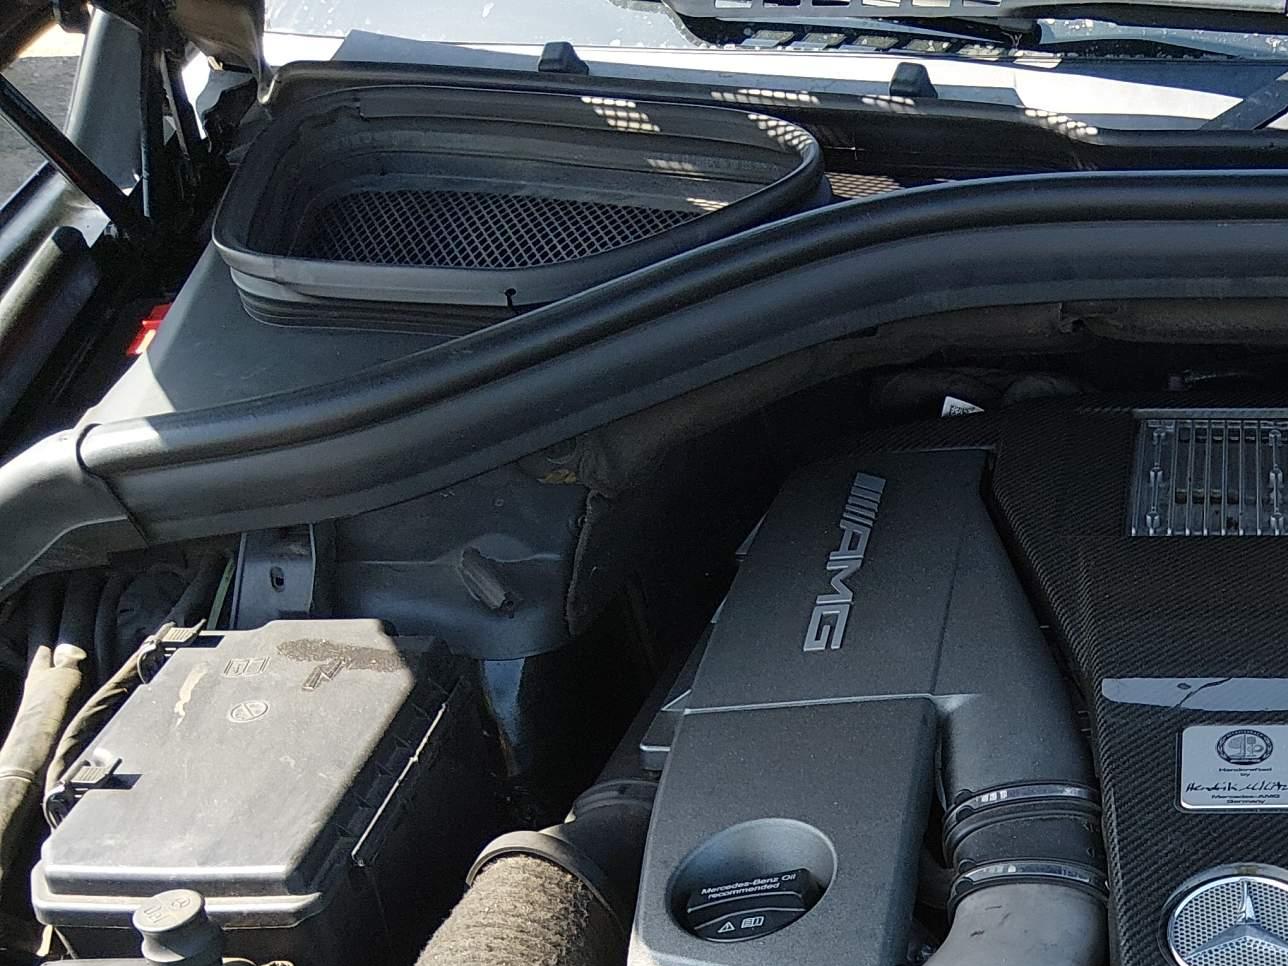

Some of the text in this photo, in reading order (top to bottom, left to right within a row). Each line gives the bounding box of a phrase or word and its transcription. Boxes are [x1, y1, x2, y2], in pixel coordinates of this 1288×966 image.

[803, 518, 871, 652] AMG
[701, 873, 797, 895] Mercedes-Benz Oil
[707, 882, 781, 900] recommended
